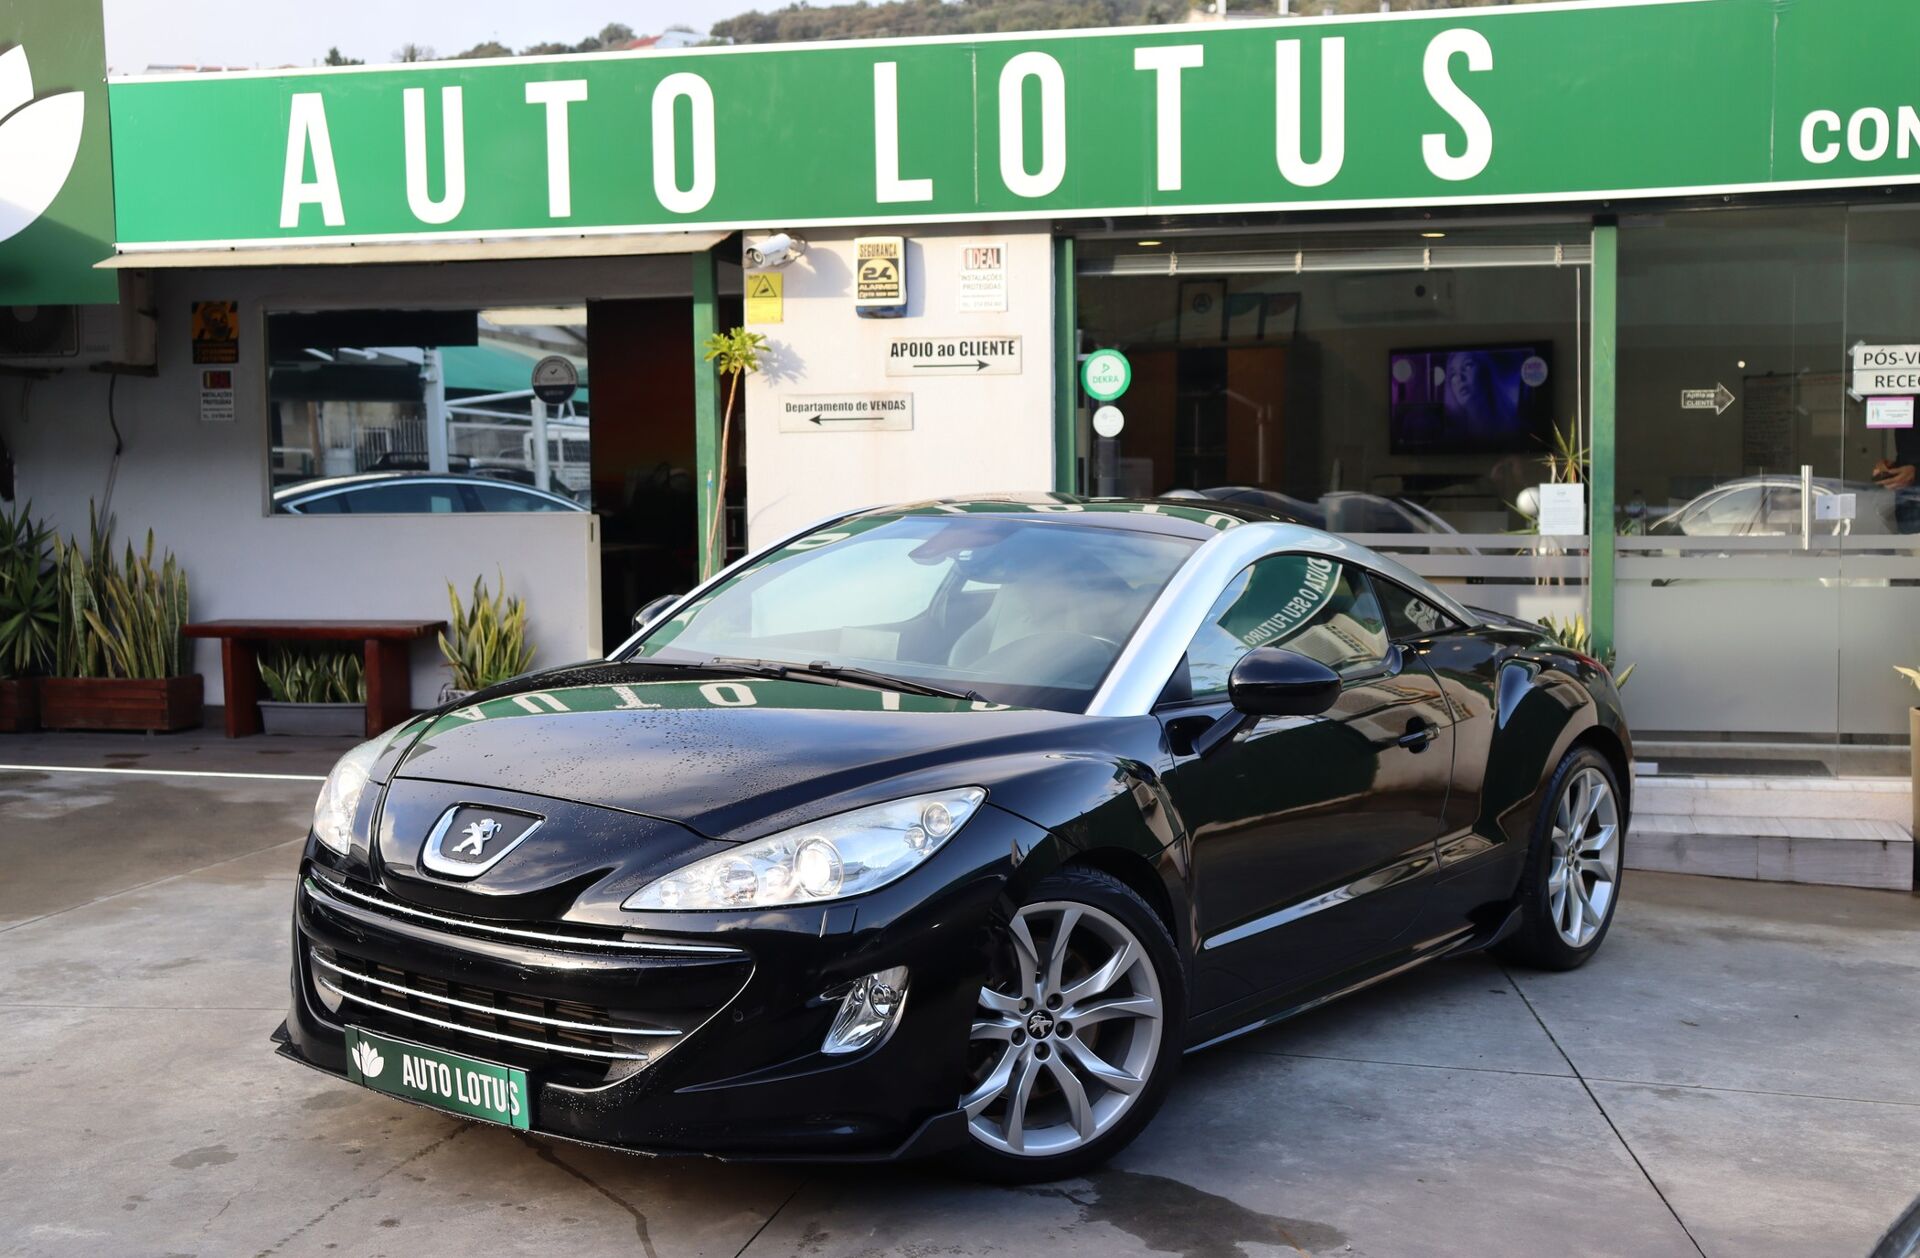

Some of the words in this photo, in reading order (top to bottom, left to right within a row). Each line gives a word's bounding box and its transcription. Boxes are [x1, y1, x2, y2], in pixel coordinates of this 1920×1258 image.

[279, 80, 716, 229] AUTO
[873, 28, 1493, 204] LOTUS
[964, 247, 1001, 270] IDEAL
[862, 266, 893, 281] 24
[890, 342, 933, 358] APOIO
[937, 344, 955, 357] ao
[959, 340, 1015, 357] CLIENTE
[1863, 348, 1920, 366] PÓS-V
[1092, 375, 1119, 384] DEKRA
[1875, 374, 1920, 389] RECE
[785, 403, 854, 413] Departamento
[856, 402, 868, 412] de
[870, 400, 906, 411] VENDAS
[402, 1053, 453, 1098] AUTO
[455, 1067, 521, 1116] LOTUS
